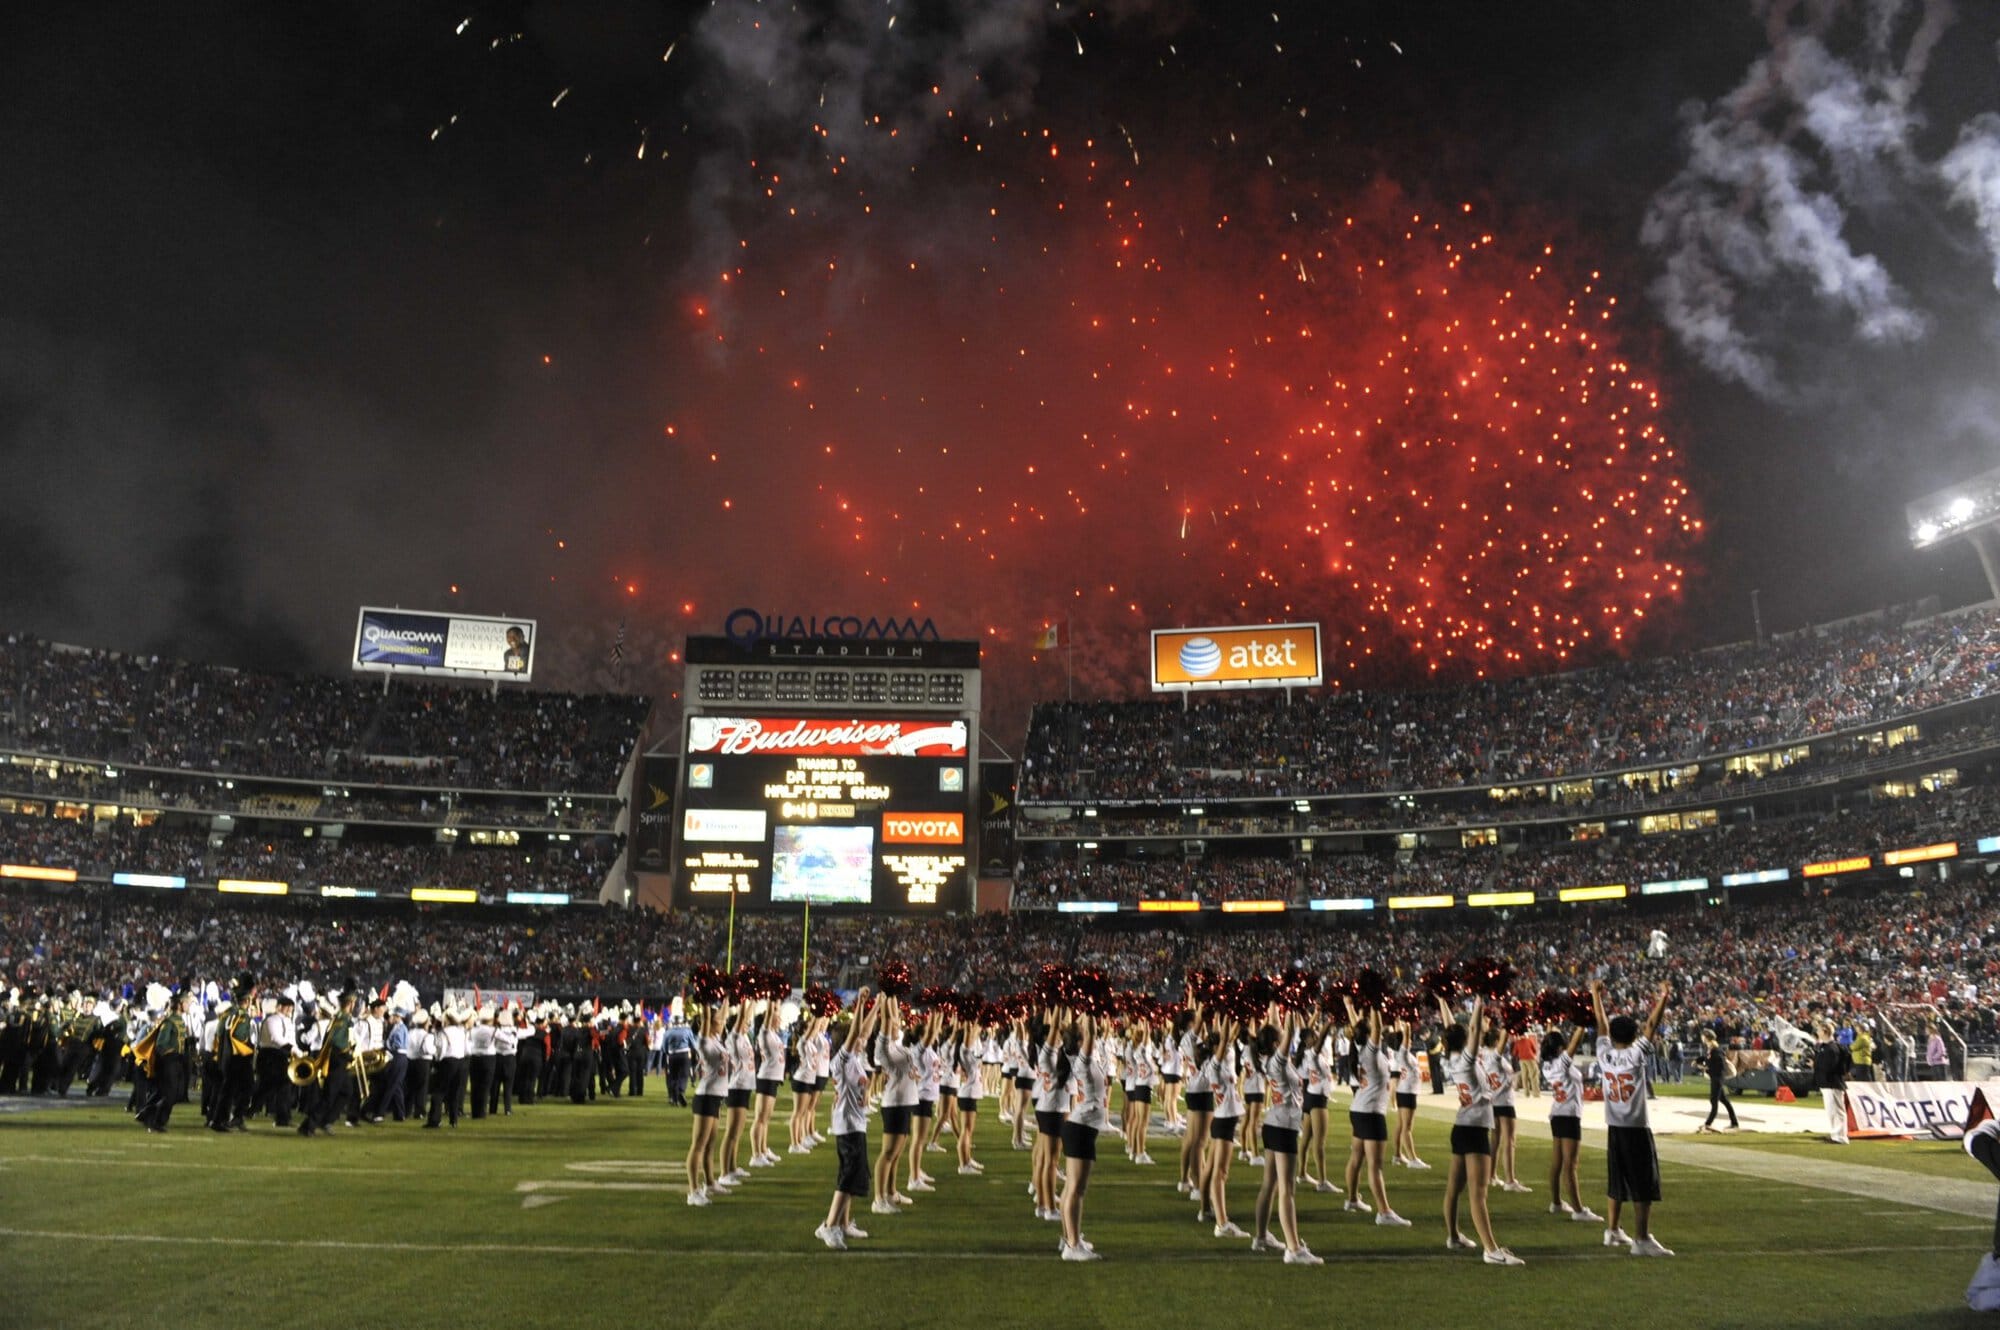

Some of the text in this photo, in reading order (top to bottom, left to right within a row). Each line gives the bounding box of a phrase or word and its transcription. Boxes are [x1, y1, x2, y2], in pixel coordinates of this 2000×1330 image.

[365, 626, 443, 643] QUALCOMM
[725, 608, 940, 651] QUALCOMM
[770, 645, 922, 656] STADIUM
[1229, 638, 1297, 668] at&t
[715, 719, 900, 754] Budweiser
[796, 758, 857, 771] THANKS TO
[786, 770, 865, 785] DR PEPPER
[887, 820, 959, 837] TOYOTA
[1858, 1094, 1966, 1129] PACIFIC
